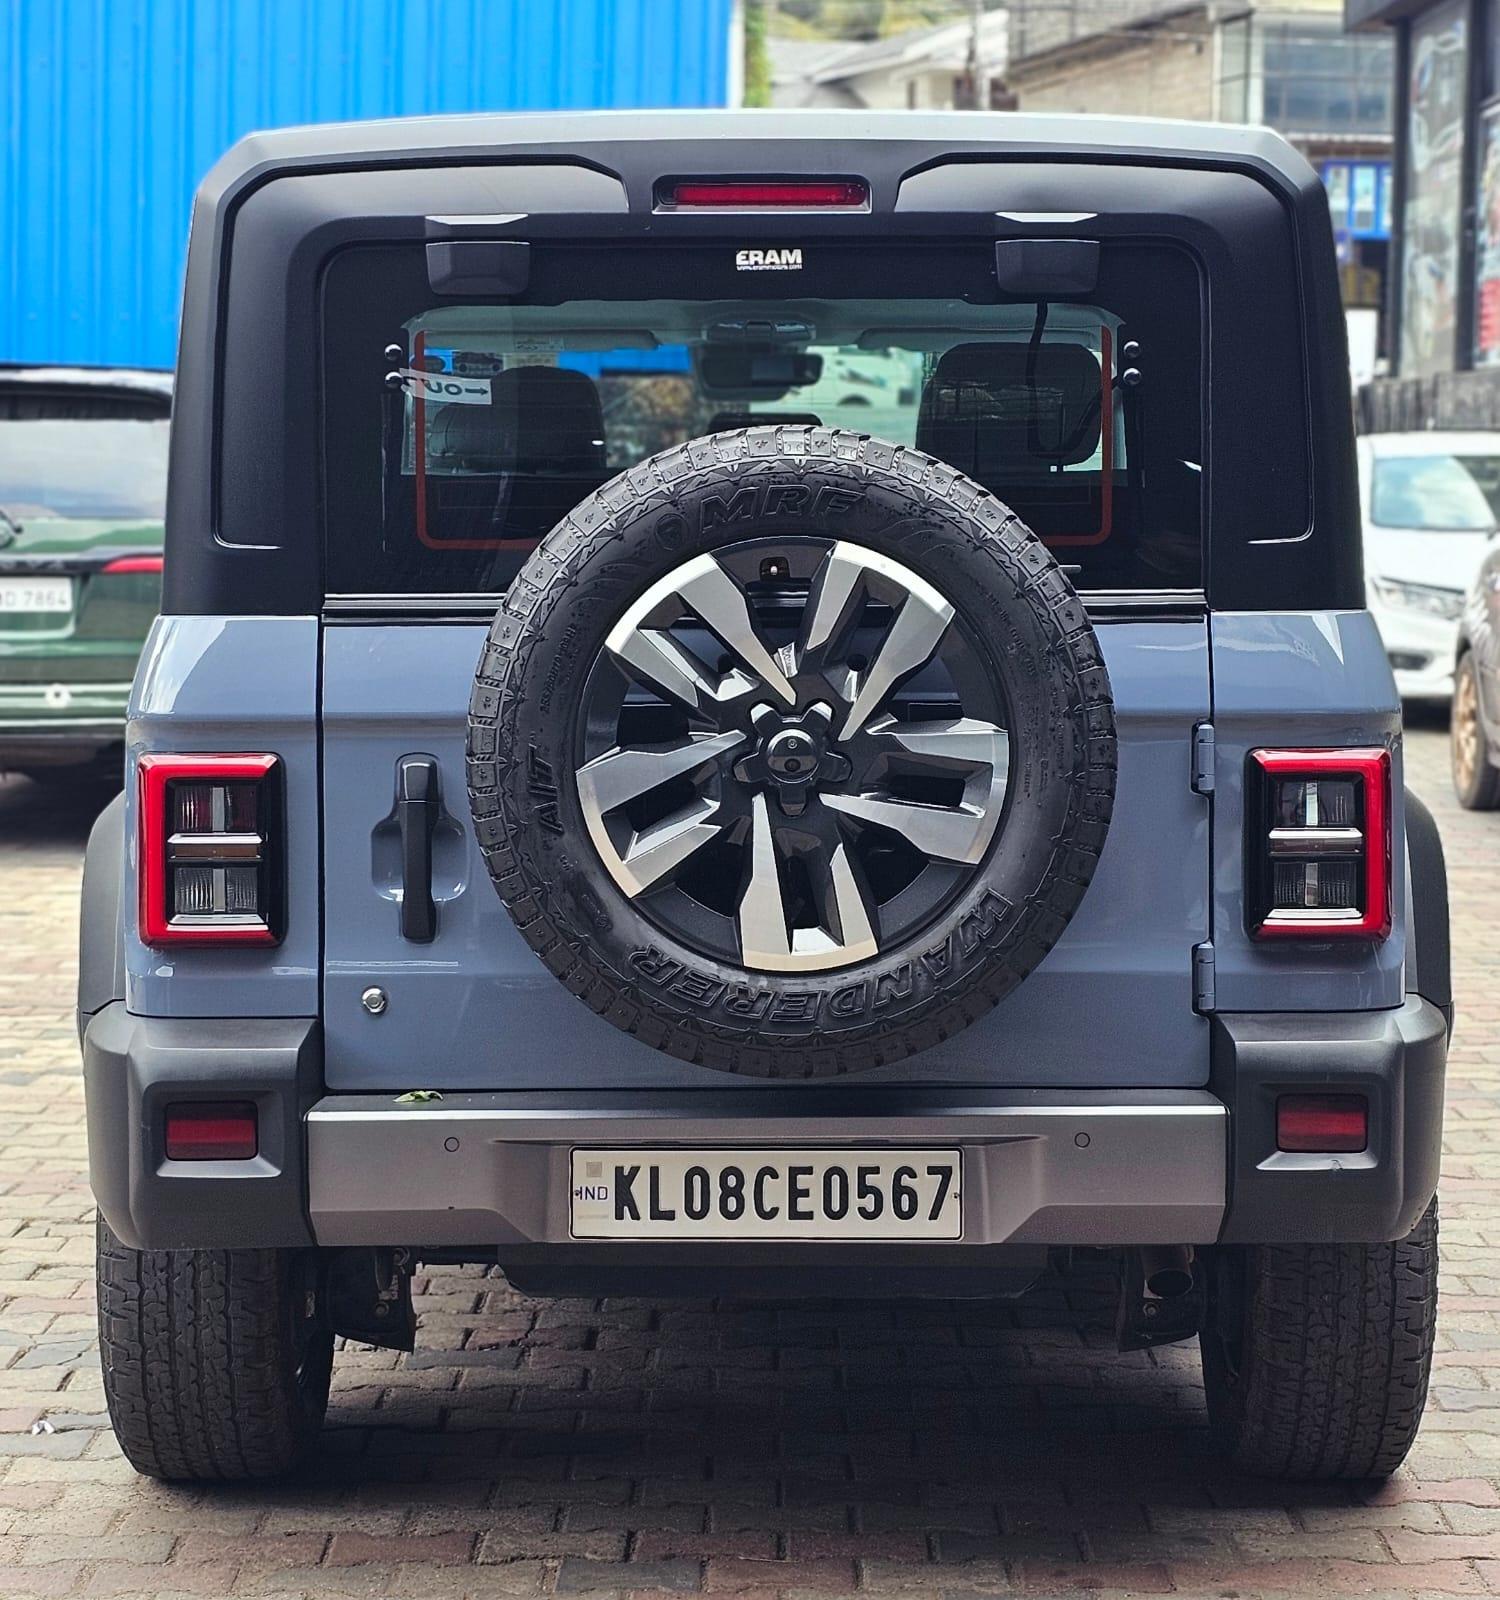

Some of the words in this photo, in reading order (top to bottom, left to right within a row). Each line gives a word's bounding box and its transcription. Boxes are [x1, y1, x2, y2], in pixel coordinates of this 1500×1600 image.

[736, 249, 802, 265] ERAM
[701, 484, 867, 533] MRF
[627, 887, 1014, 1023] WANDERER
[578, 1185, 608, 1201] IND
[613, 1165, 954, 1221] KL08CE0567
